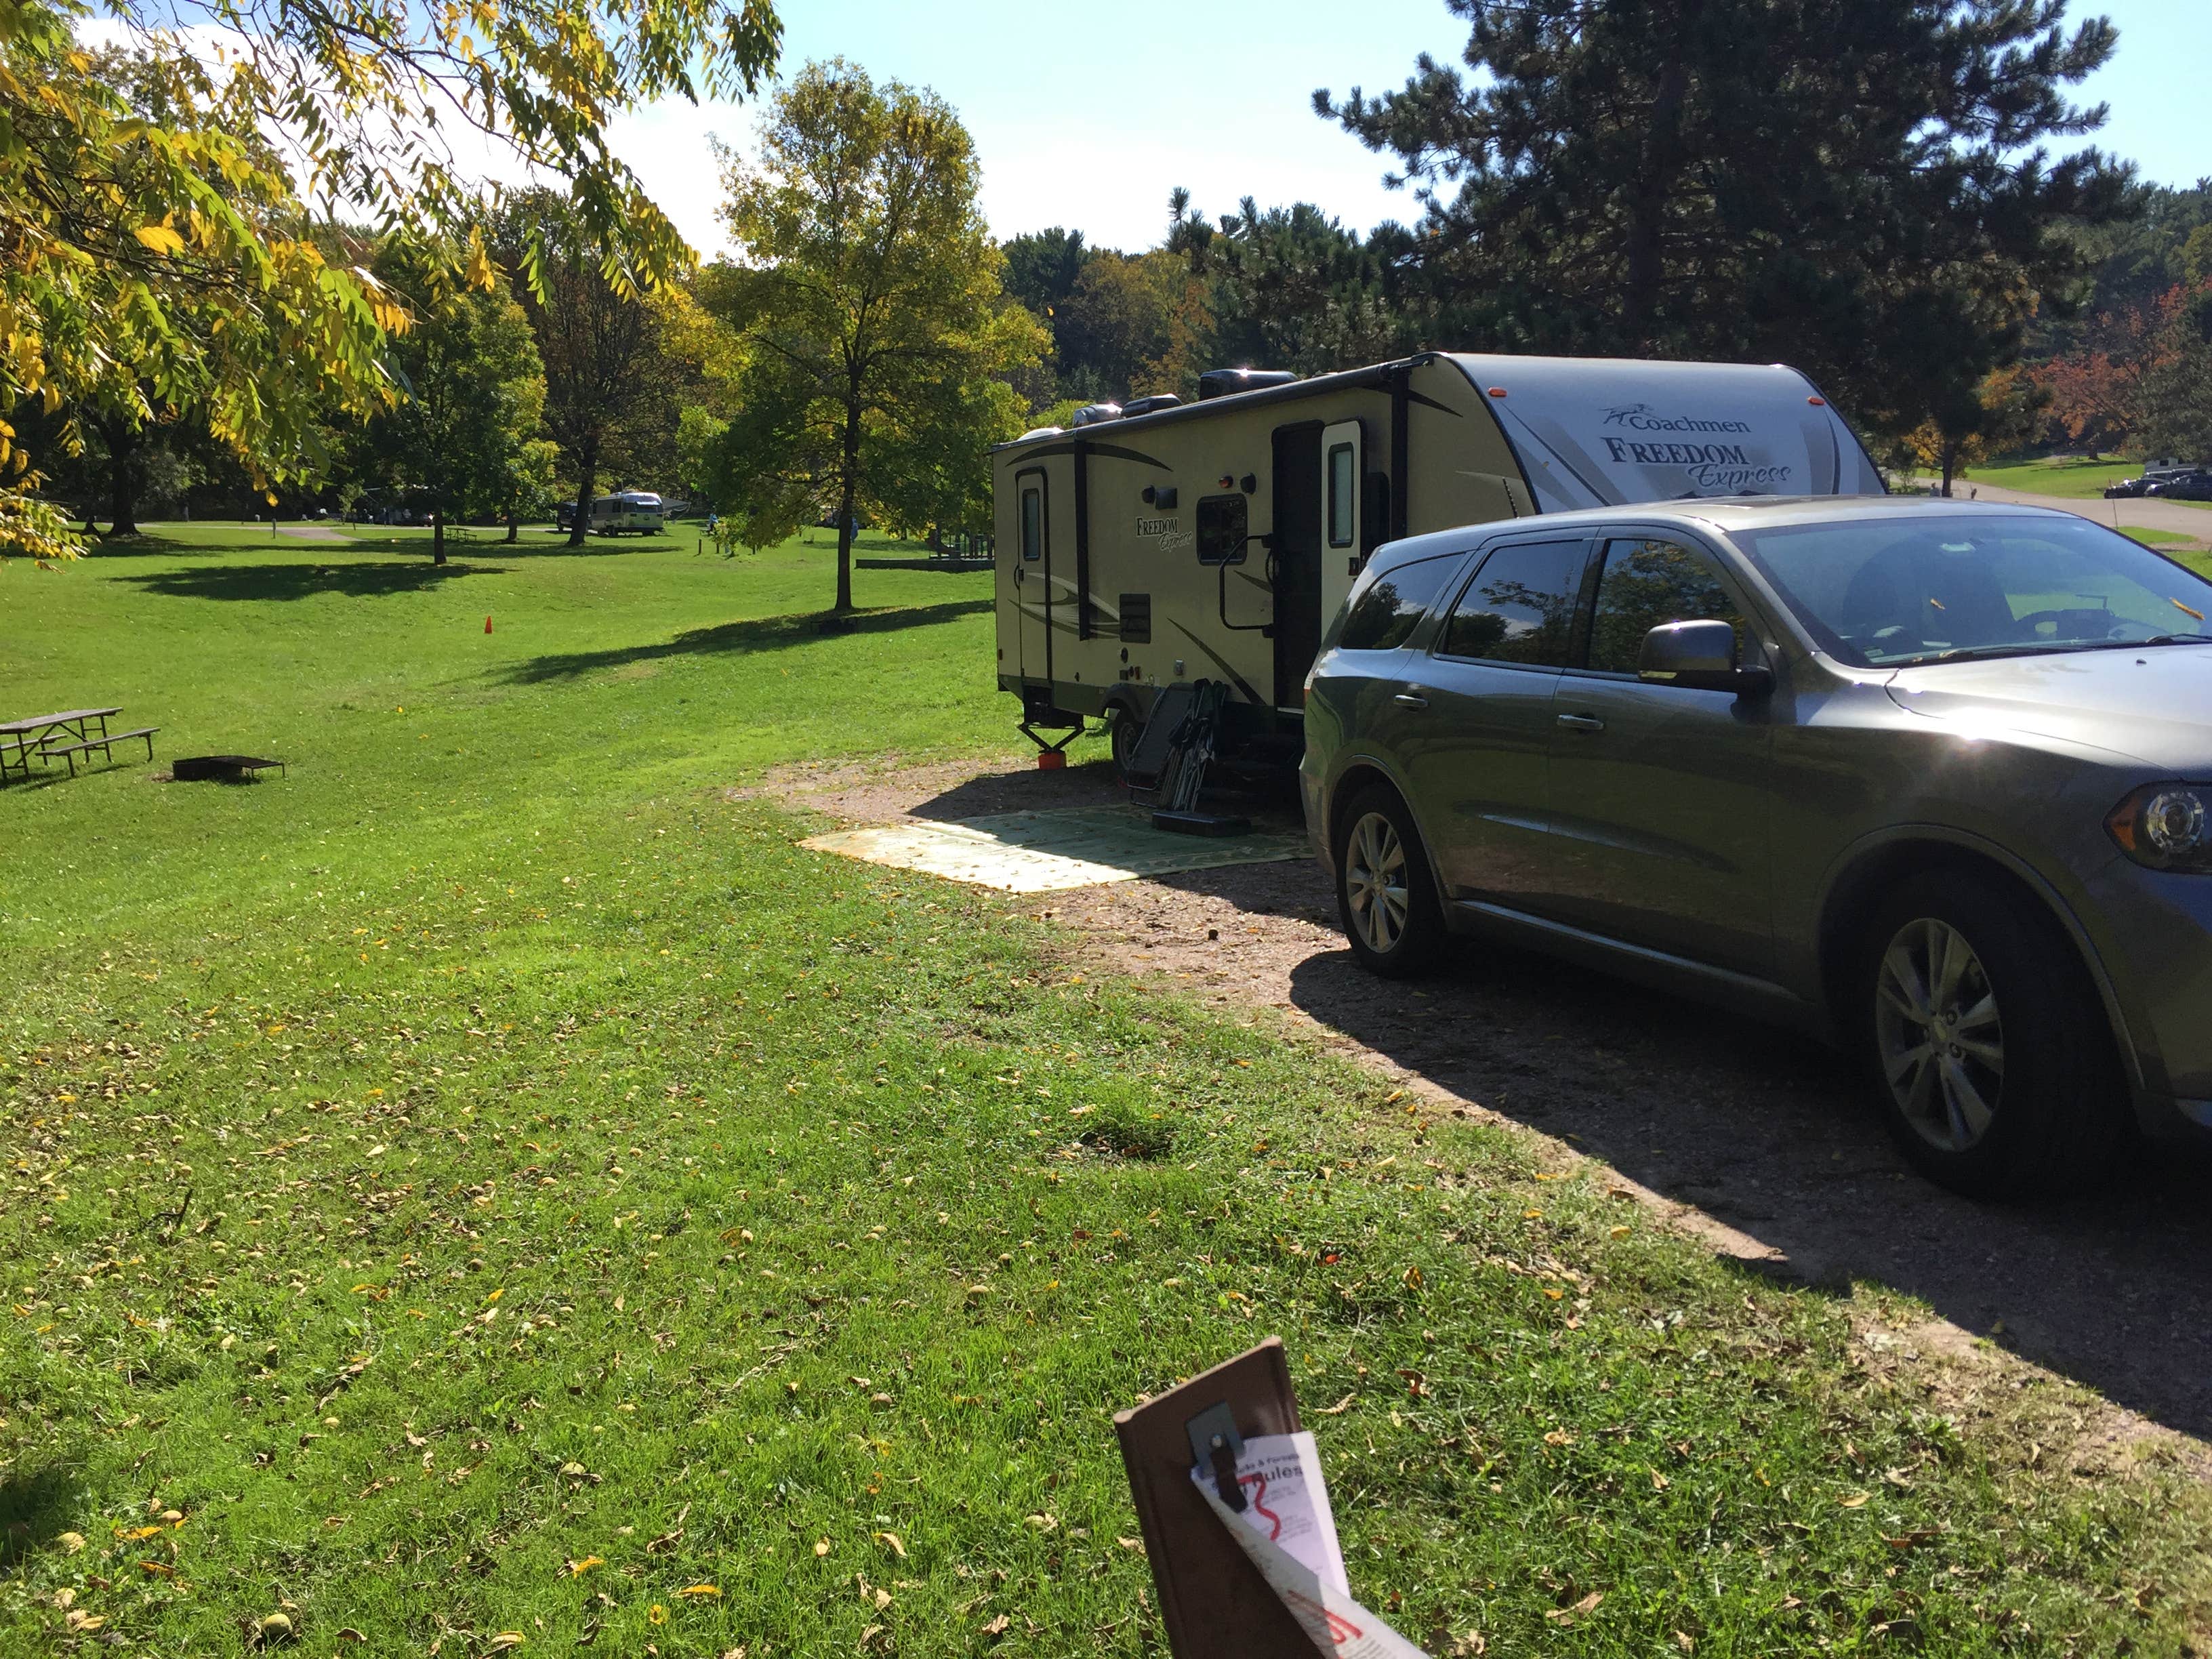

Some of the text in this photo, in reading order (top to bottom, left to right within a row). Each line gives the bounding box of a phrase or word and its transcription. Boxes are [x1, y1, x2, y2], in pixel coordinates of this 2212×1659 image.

[1629, 415, 1752, 434] Coachmen
[1600, 436, 1750, 465] FREEDOM
[1688, 463, 1792, 489] Express
[1136, 517, 1179, 537] FREEDOM
